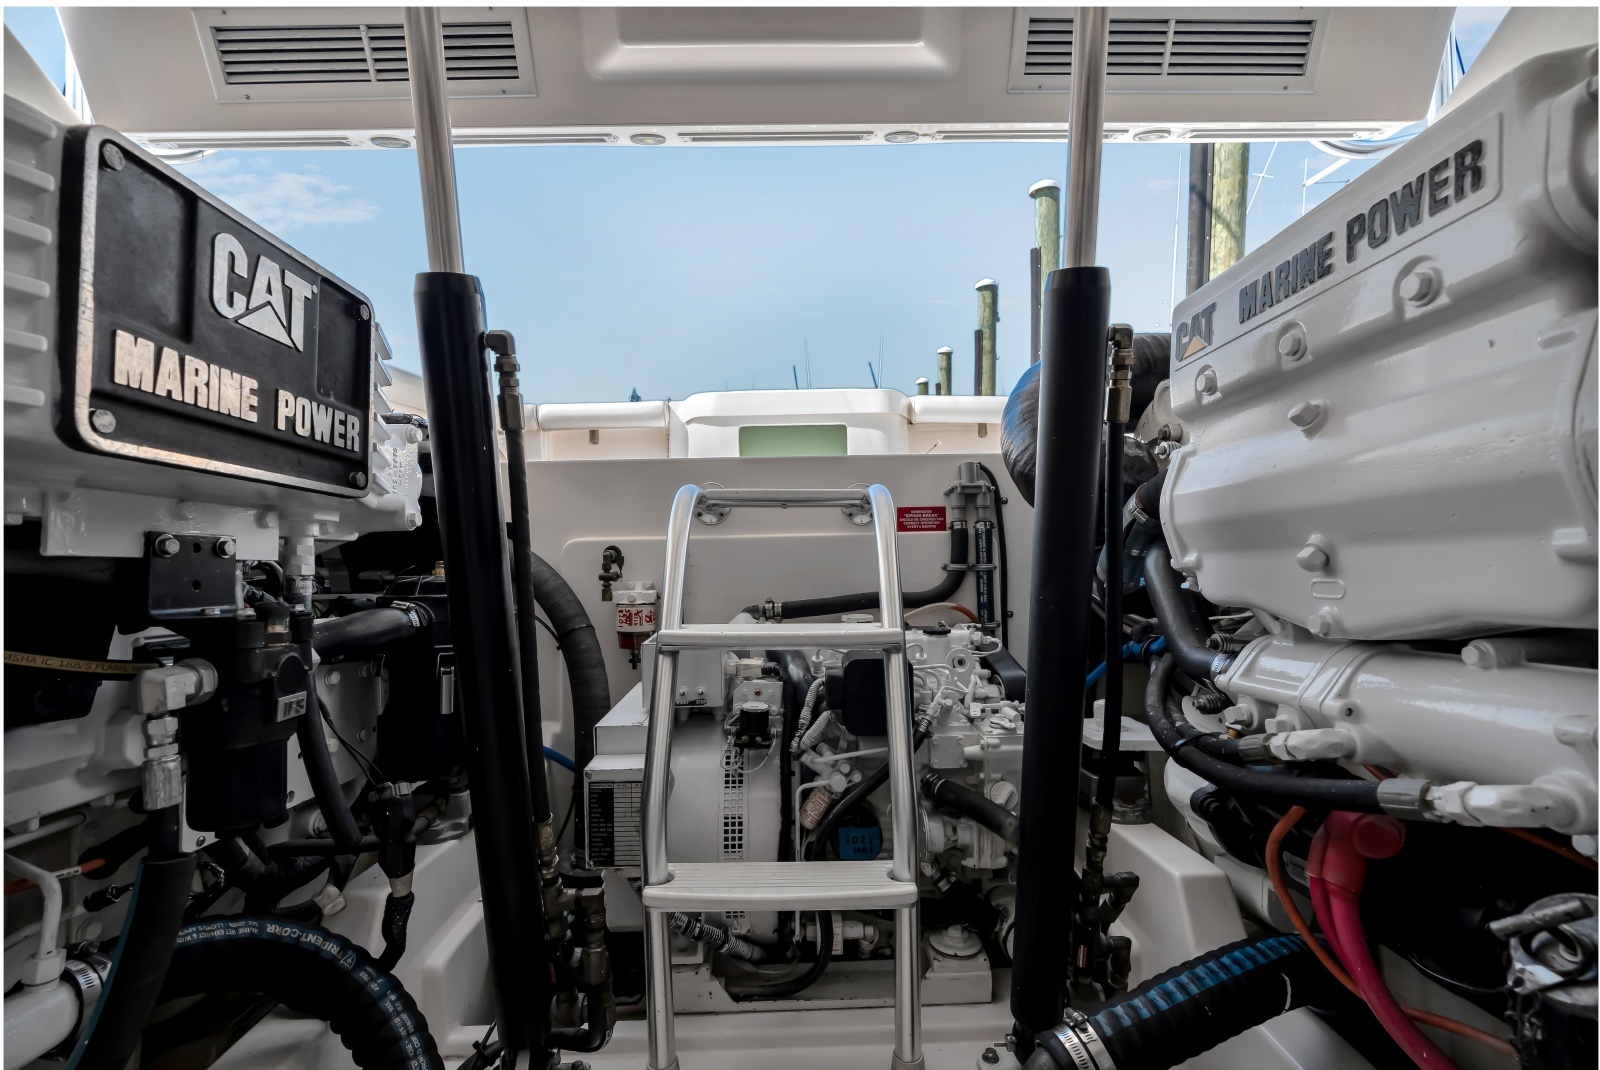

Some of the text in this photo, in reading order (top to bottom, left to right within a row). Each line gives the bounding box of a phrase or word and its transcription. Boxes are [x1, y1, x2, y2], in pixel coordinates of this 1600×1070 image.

[212, 232, 313, 352] CAT
[1175, 138, 1485, 363] CAT MARINE POWER
[114, 329, 360, 452] MARINE POWER
[41, 658, 92, 670] IC-188/5
[266, 924, 343, 959] TRIDENT-CORR
